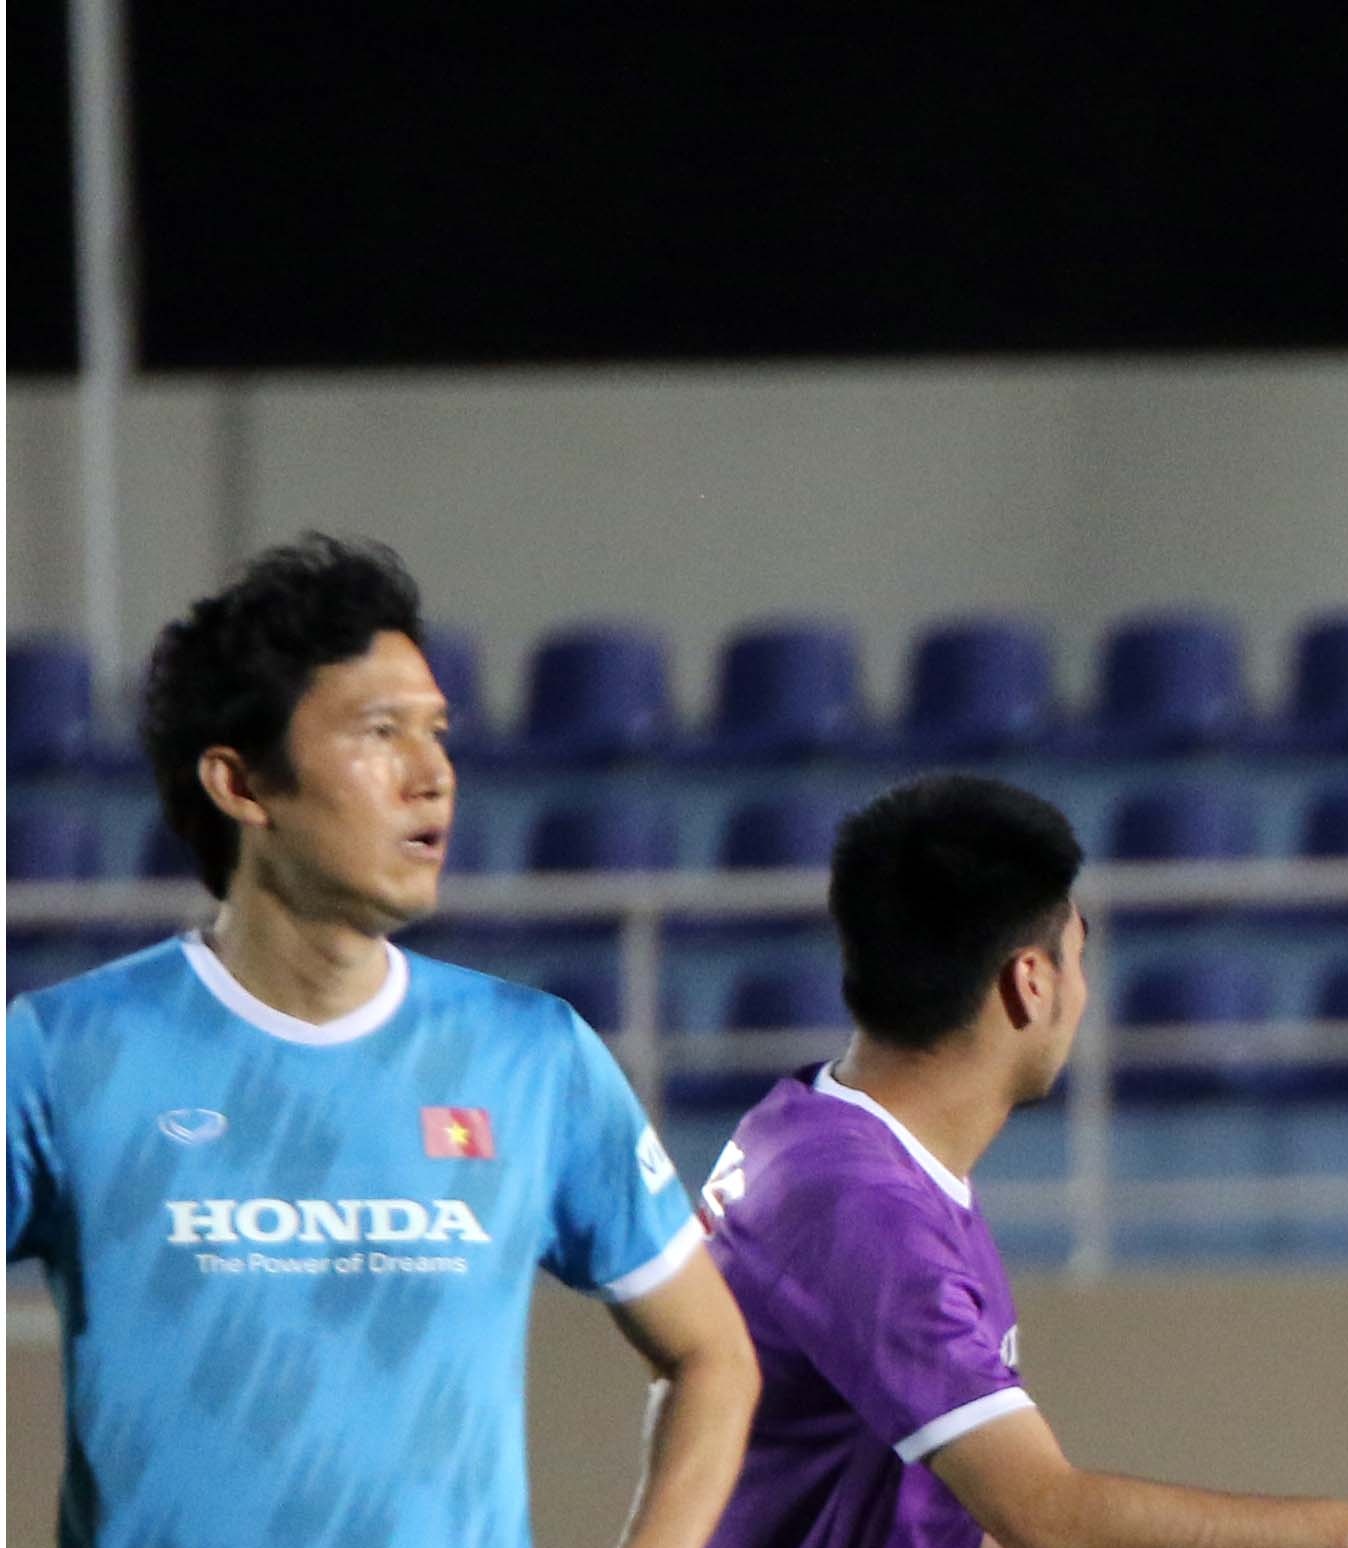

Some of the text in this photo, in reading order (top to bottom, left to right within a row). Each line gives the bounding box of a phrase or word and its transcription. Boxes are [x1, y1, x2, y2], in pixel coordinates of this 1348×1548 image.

[165, 1197, 493, 1243] HONDA
[195, 1251, 469, 1275] The Power of Dreams
